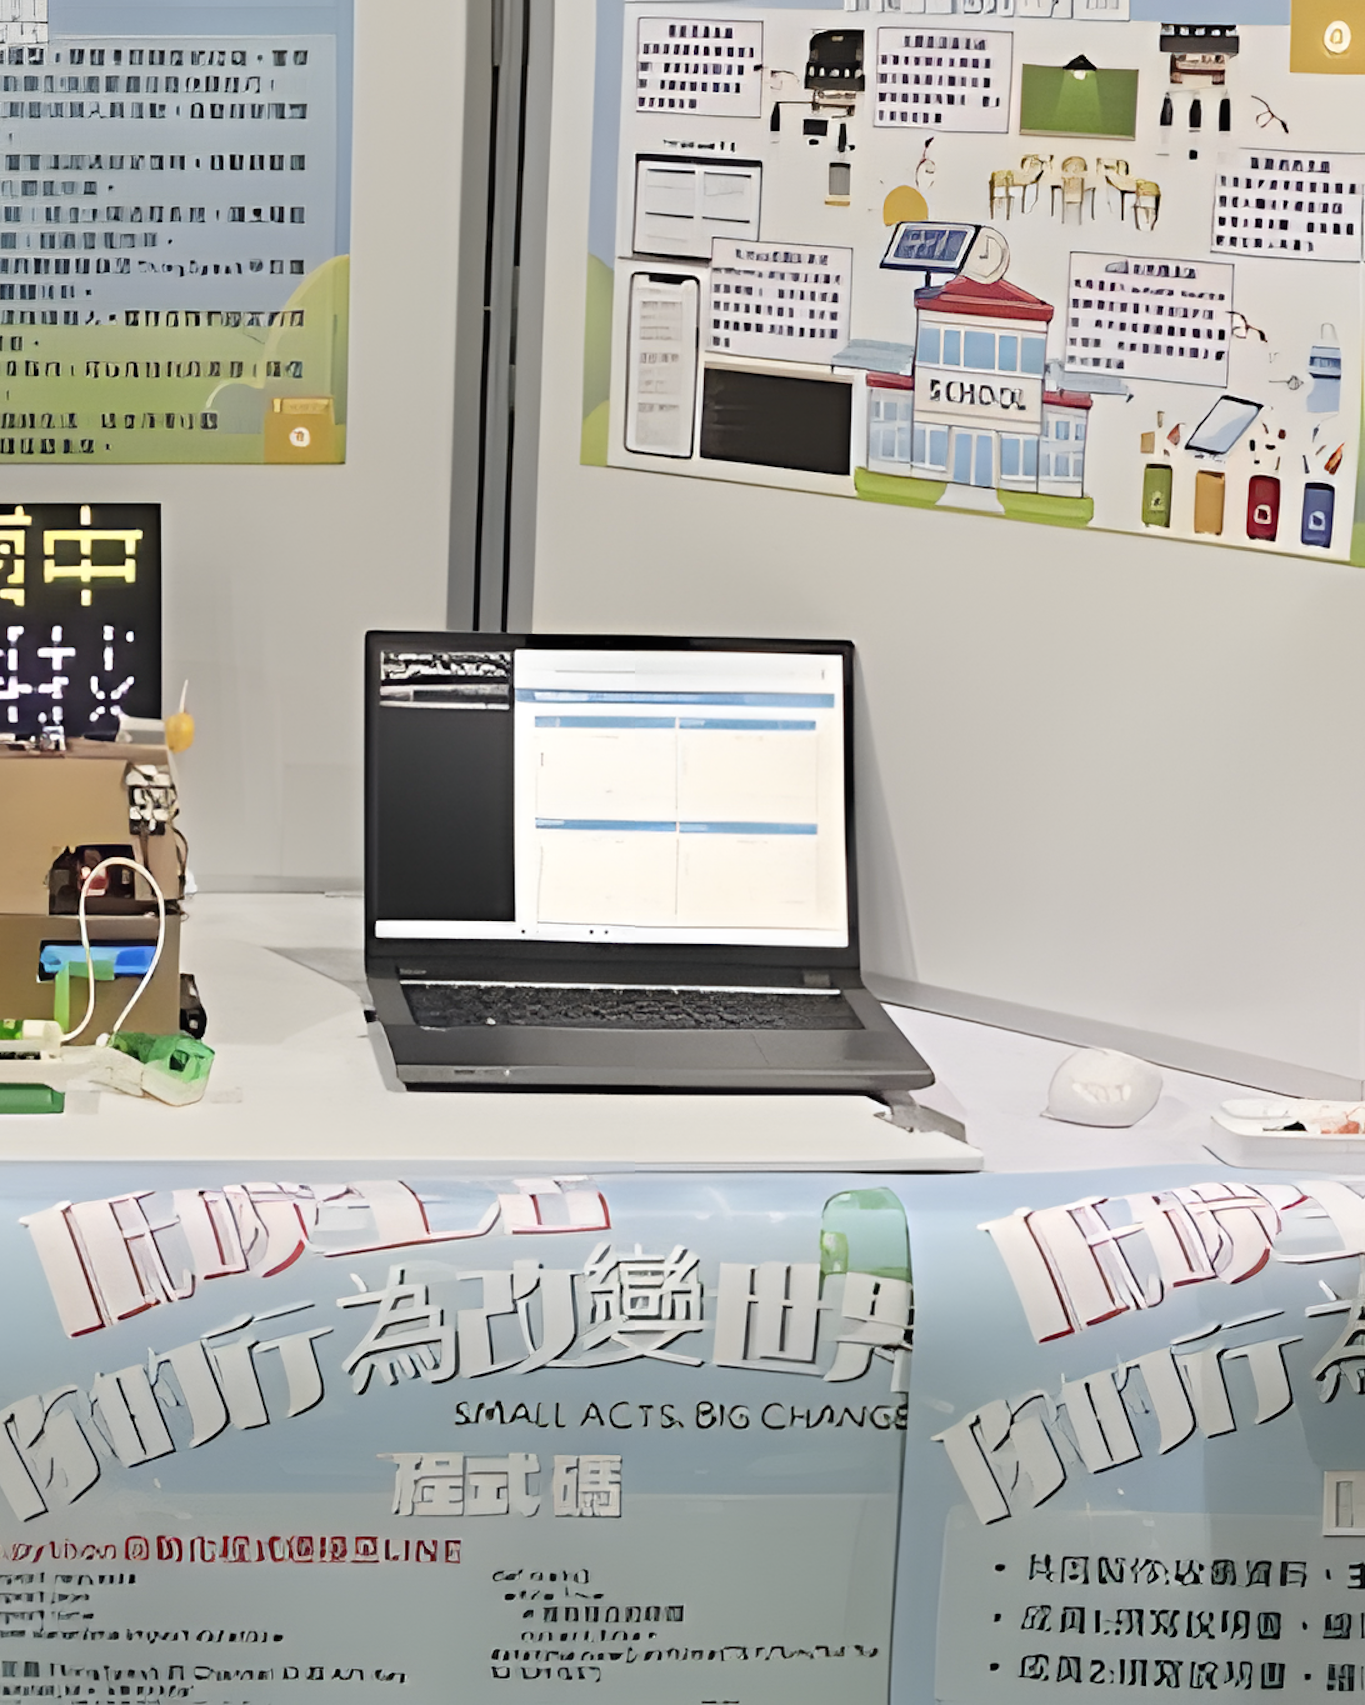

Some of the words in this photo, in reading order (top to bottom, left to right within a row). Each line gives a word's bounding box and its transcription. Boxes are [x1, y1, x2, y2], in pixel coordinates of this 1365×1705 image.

[454, 1401, 566, 1429] SMALL
[695, 1401, 750, 1430] BIG
[761, 1402, 910, 1432] CHANGE
[377, 1452, 623, 1518] 程式碼
